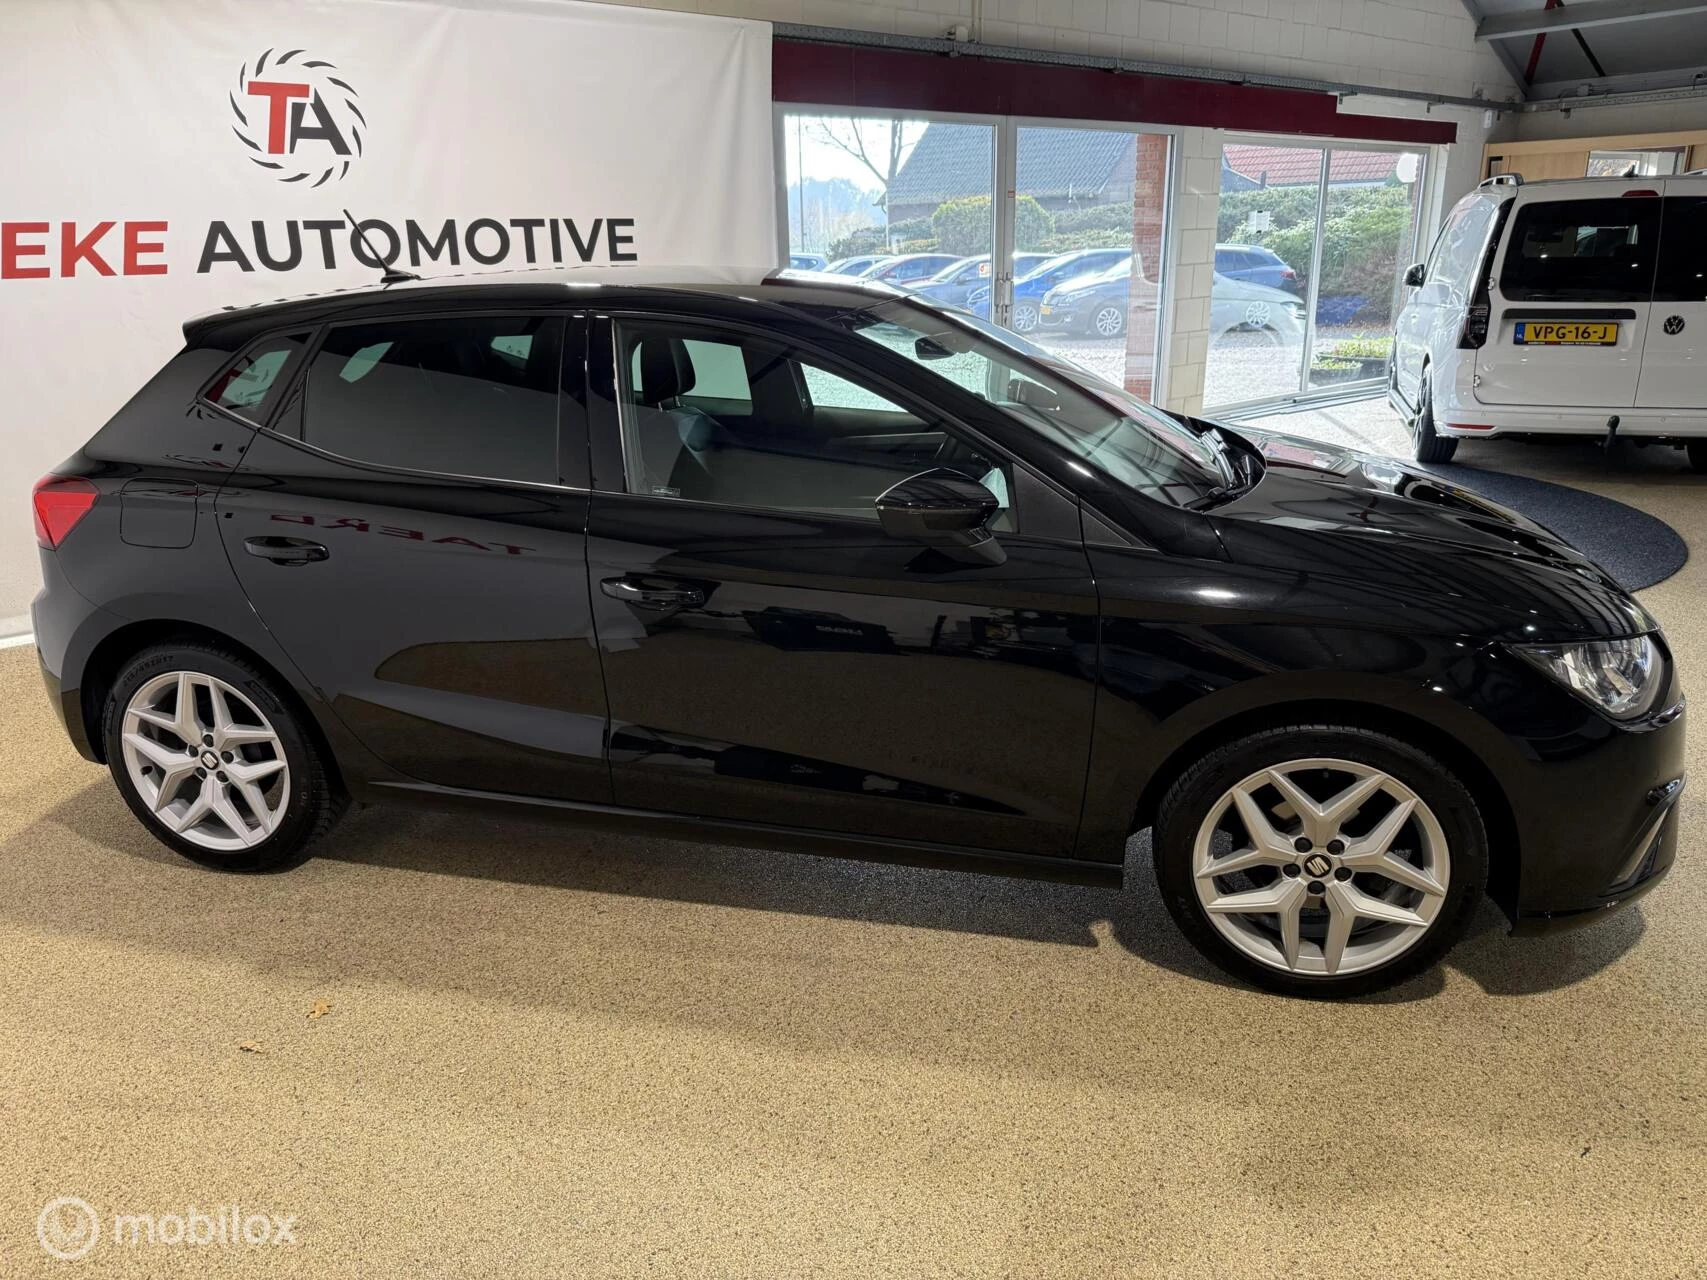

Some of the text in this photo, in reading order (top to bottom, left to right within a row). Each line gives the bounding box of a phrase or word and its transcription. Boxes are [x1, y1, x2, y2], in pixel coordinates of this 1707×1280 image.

[247, 80, 353, 156] TA
[0, 218, 638, 280] EKE AUTOMOTIVE
[1533, 325, 1608, 340] VPG-16-J
